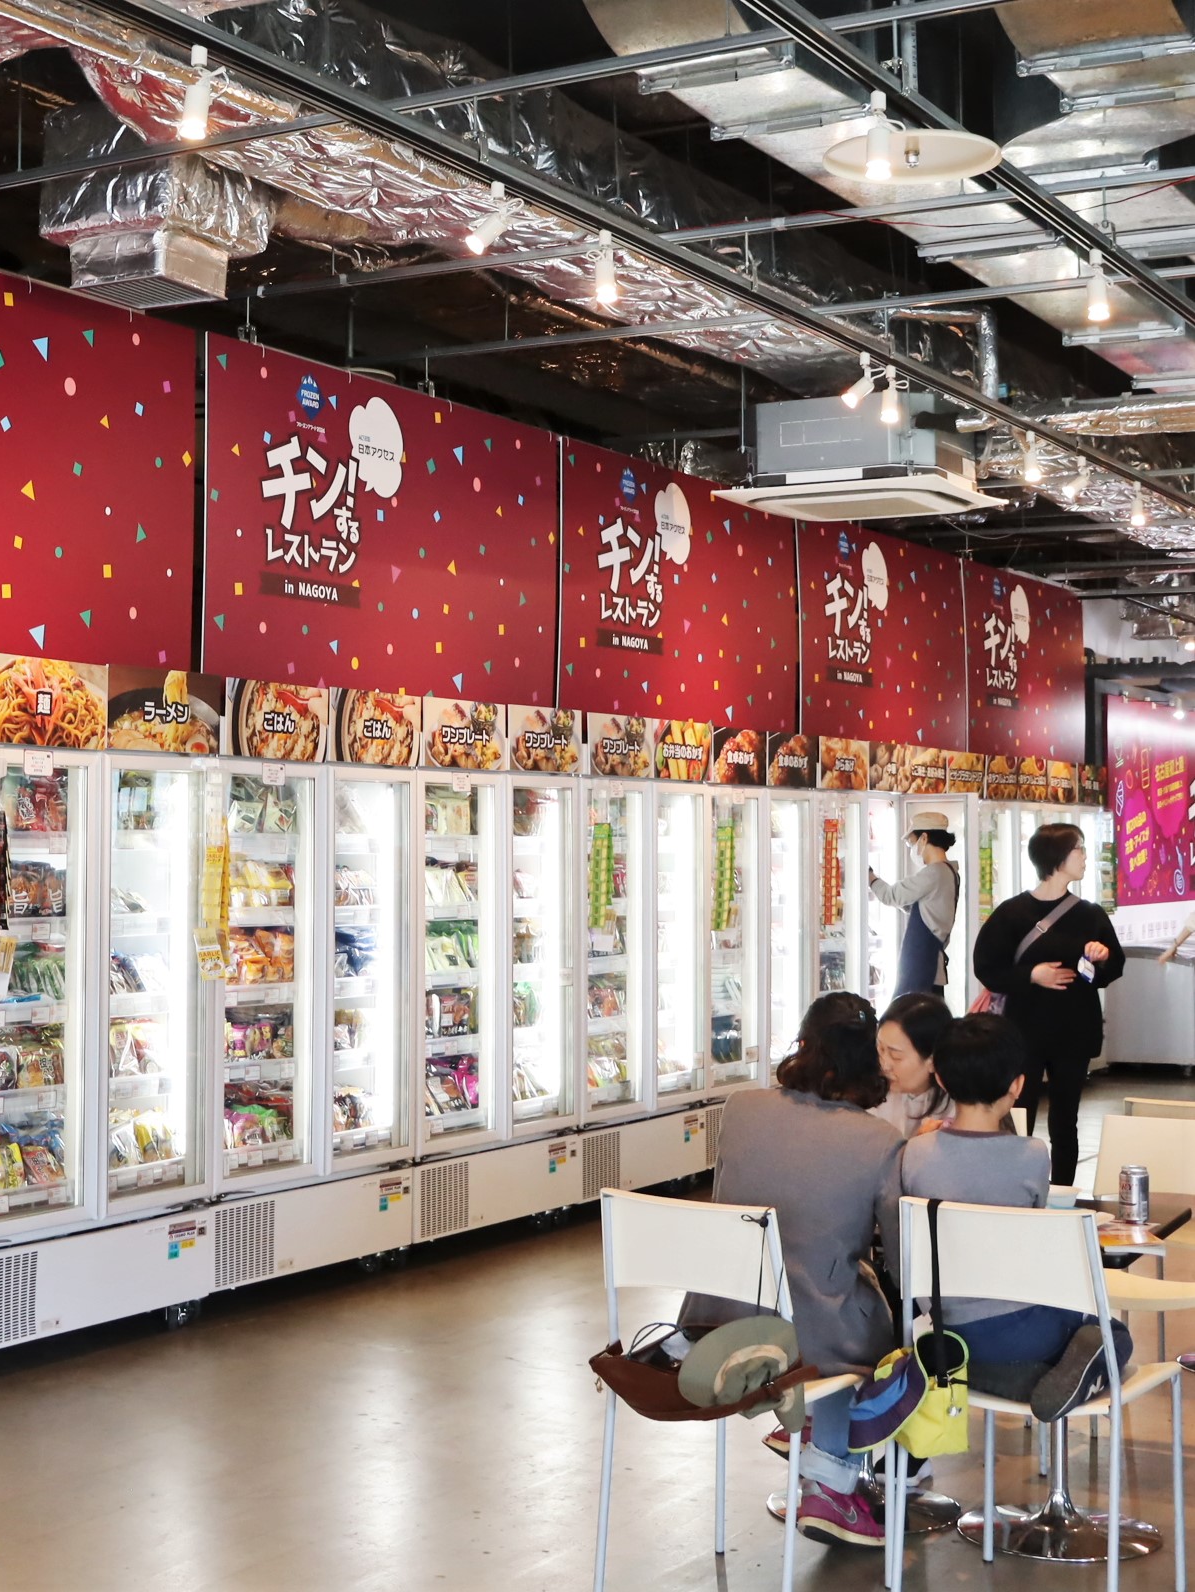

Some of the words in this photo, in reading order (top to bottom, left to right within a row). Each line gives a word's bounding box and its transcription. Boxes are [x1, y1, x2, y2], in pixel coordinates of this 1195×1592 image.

[301, 389, 320, 401] FROZEN
[302, 398, 319, 409] AWARD
[358, 443, 395, 462] 日本アクセス
[334, 506, 360, 544] する
[266, 528, 356, 573] レストラン
[284, 580, 294, 594] in
[298, 583, 338, 601] NAGOYA
[645, 572, 663, 603] する
[600, 592, 660, 628] レストラン
[612, 633, 620, 645] in
[621, 635, 648, 650] NAGOYA
[827, 636, 870, 664] レストラン
[986, 668, 1017, 691] レストラン
[37, 692, 51, 715] 麺
[144, 702, 190, 724] ラーメン
[263, 712, 296, 734] ごはん
[363, 720, 392, 740] ごはん
[442, 726, 490, 746] ワンプレート
[525, 732, 568, 750] ワンプレート
[603, 738, 641, 755] ワンプレート
[663, 743, 703, 760] お弁当のおかず
